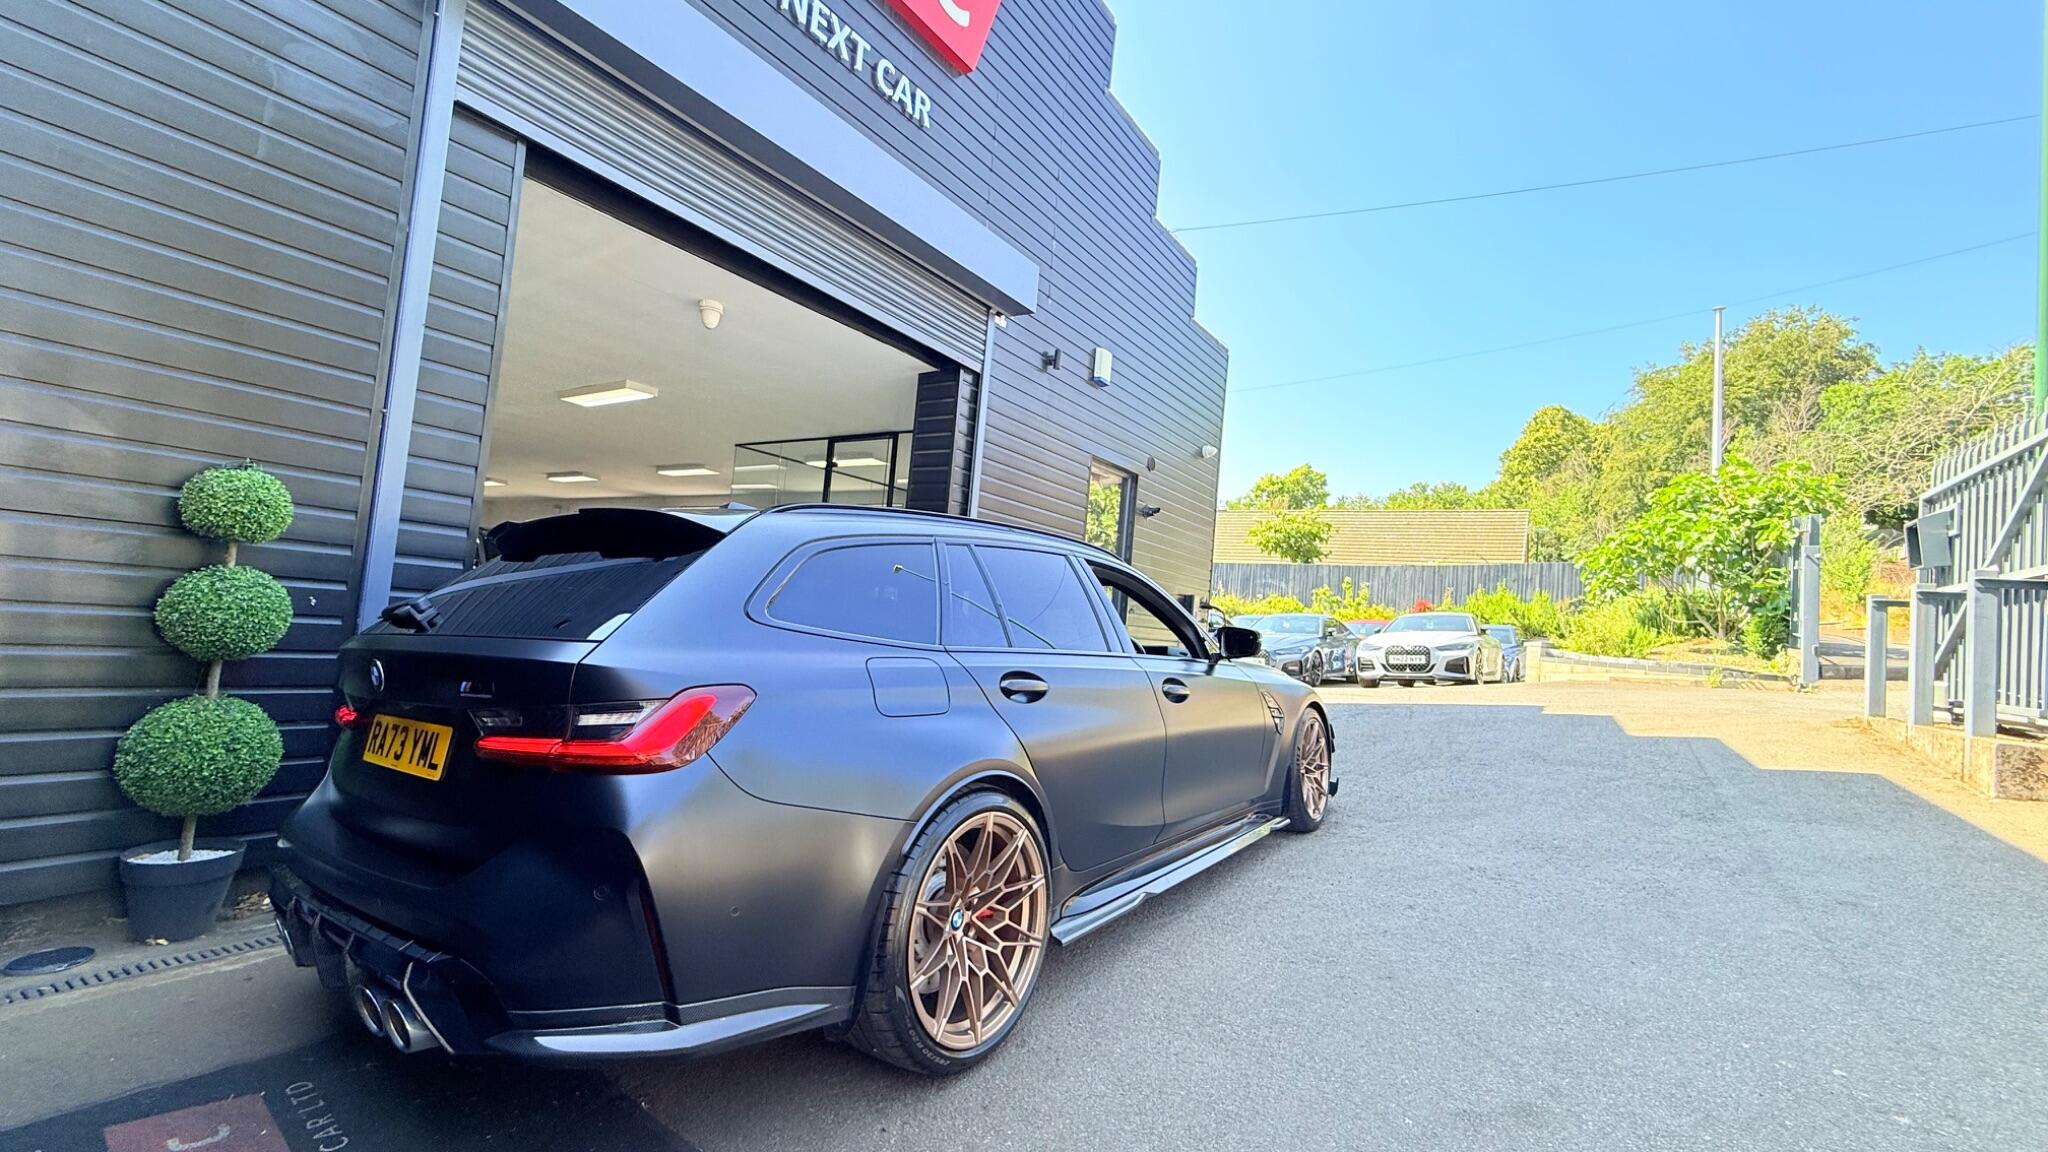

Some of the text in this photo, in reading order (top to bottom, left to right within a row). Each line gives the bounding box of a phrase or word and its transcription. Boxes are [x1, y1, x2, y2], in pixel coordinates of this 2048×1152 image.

[780, 0, 932, 129] NEXT CAR
[366, 720, 440, 771] RA73 YML
[285, 1081, 349, 1152] CAR LTD
